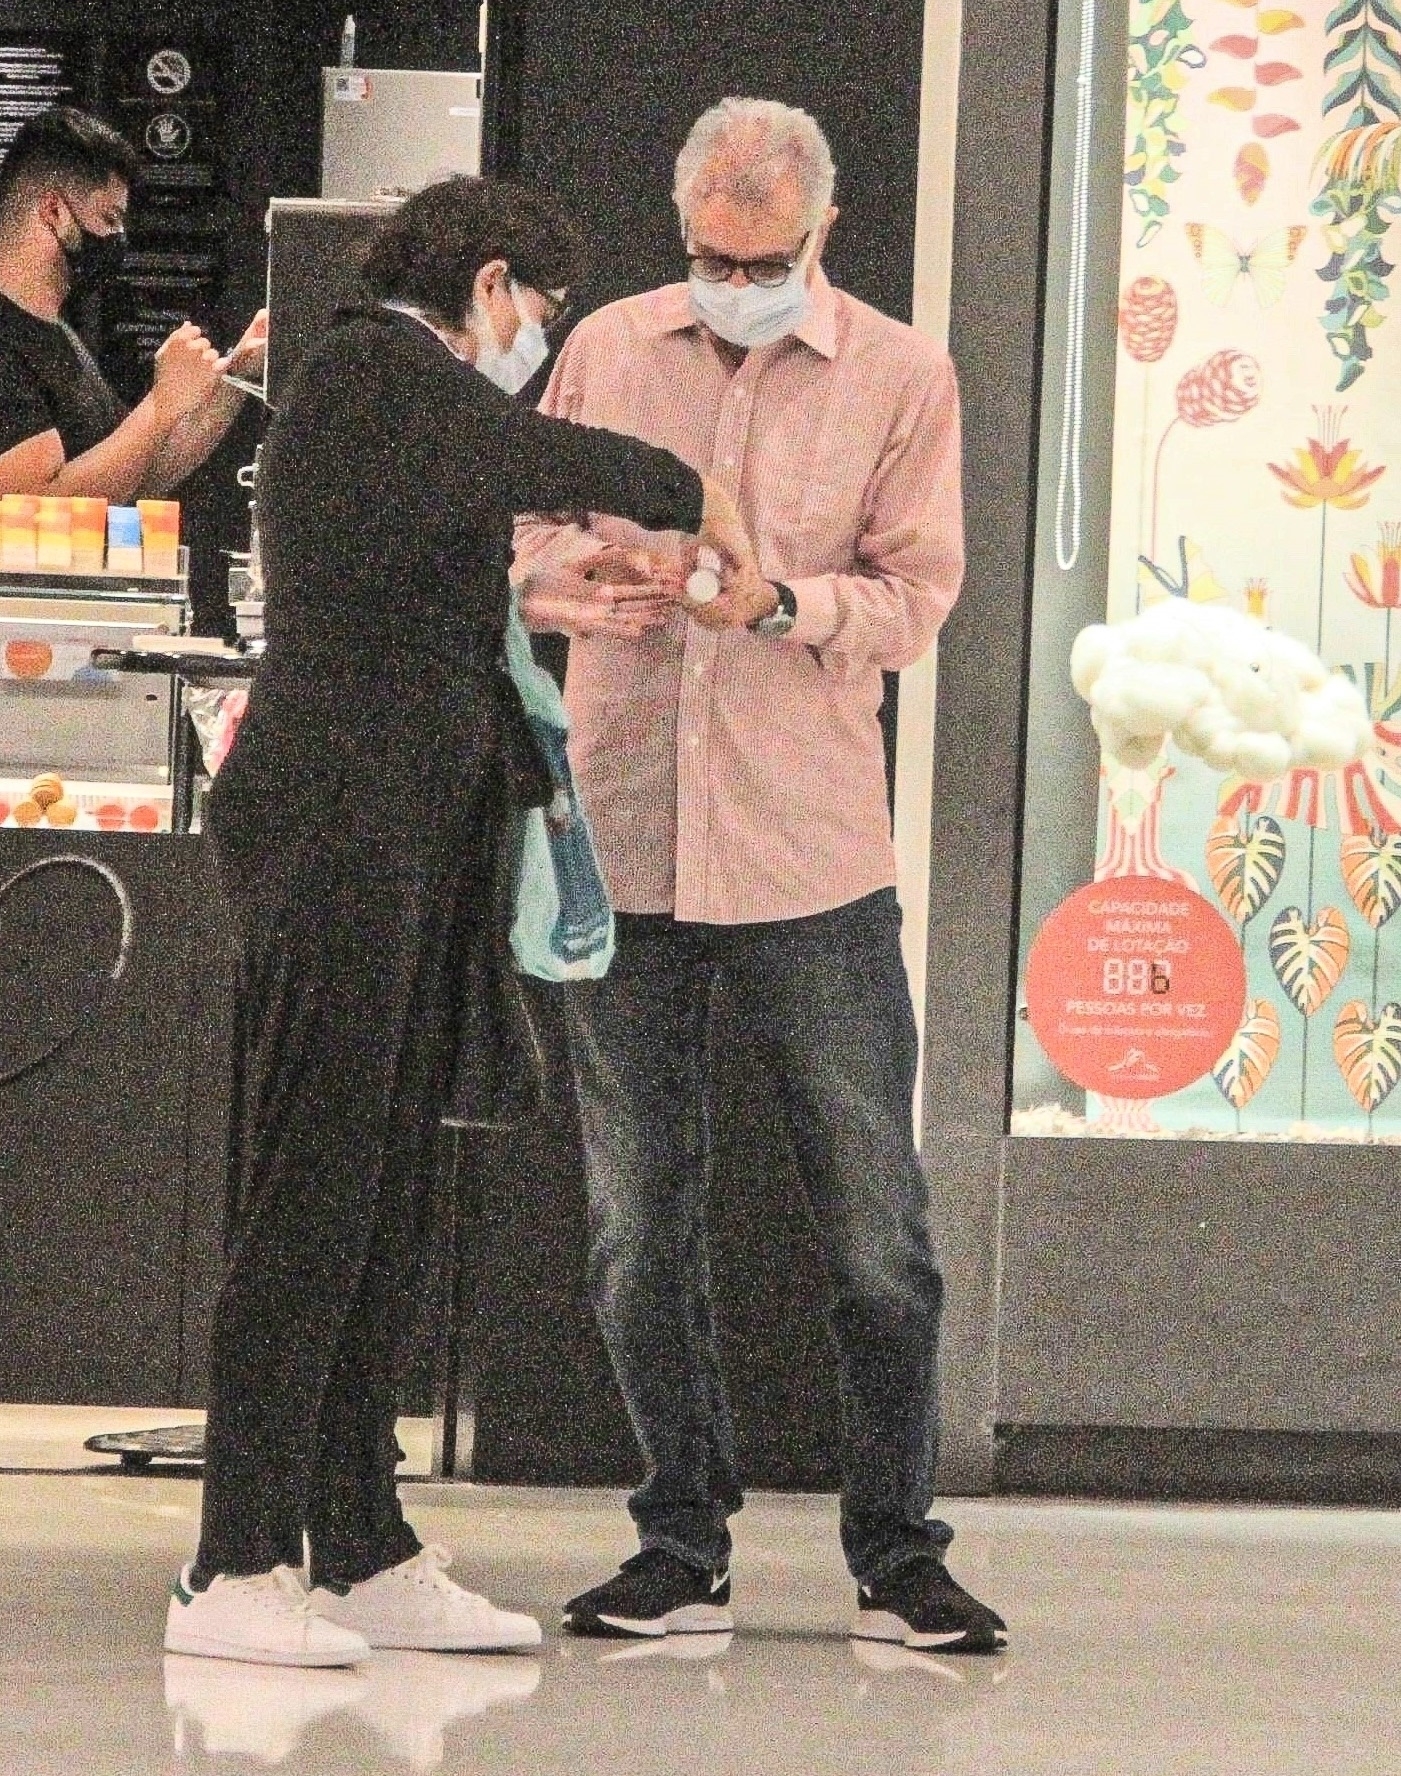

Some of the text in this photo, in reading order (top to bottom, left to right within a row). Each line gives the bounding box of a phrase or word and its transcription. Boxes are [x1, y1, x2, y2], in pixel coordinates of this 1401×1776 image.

[1087, 900, 1190, 916] CAPACIDADE
[1087, 938, 1109, 952] DE
[1066, 1000, 1207, 1018] PESSOAS POR VEZ
